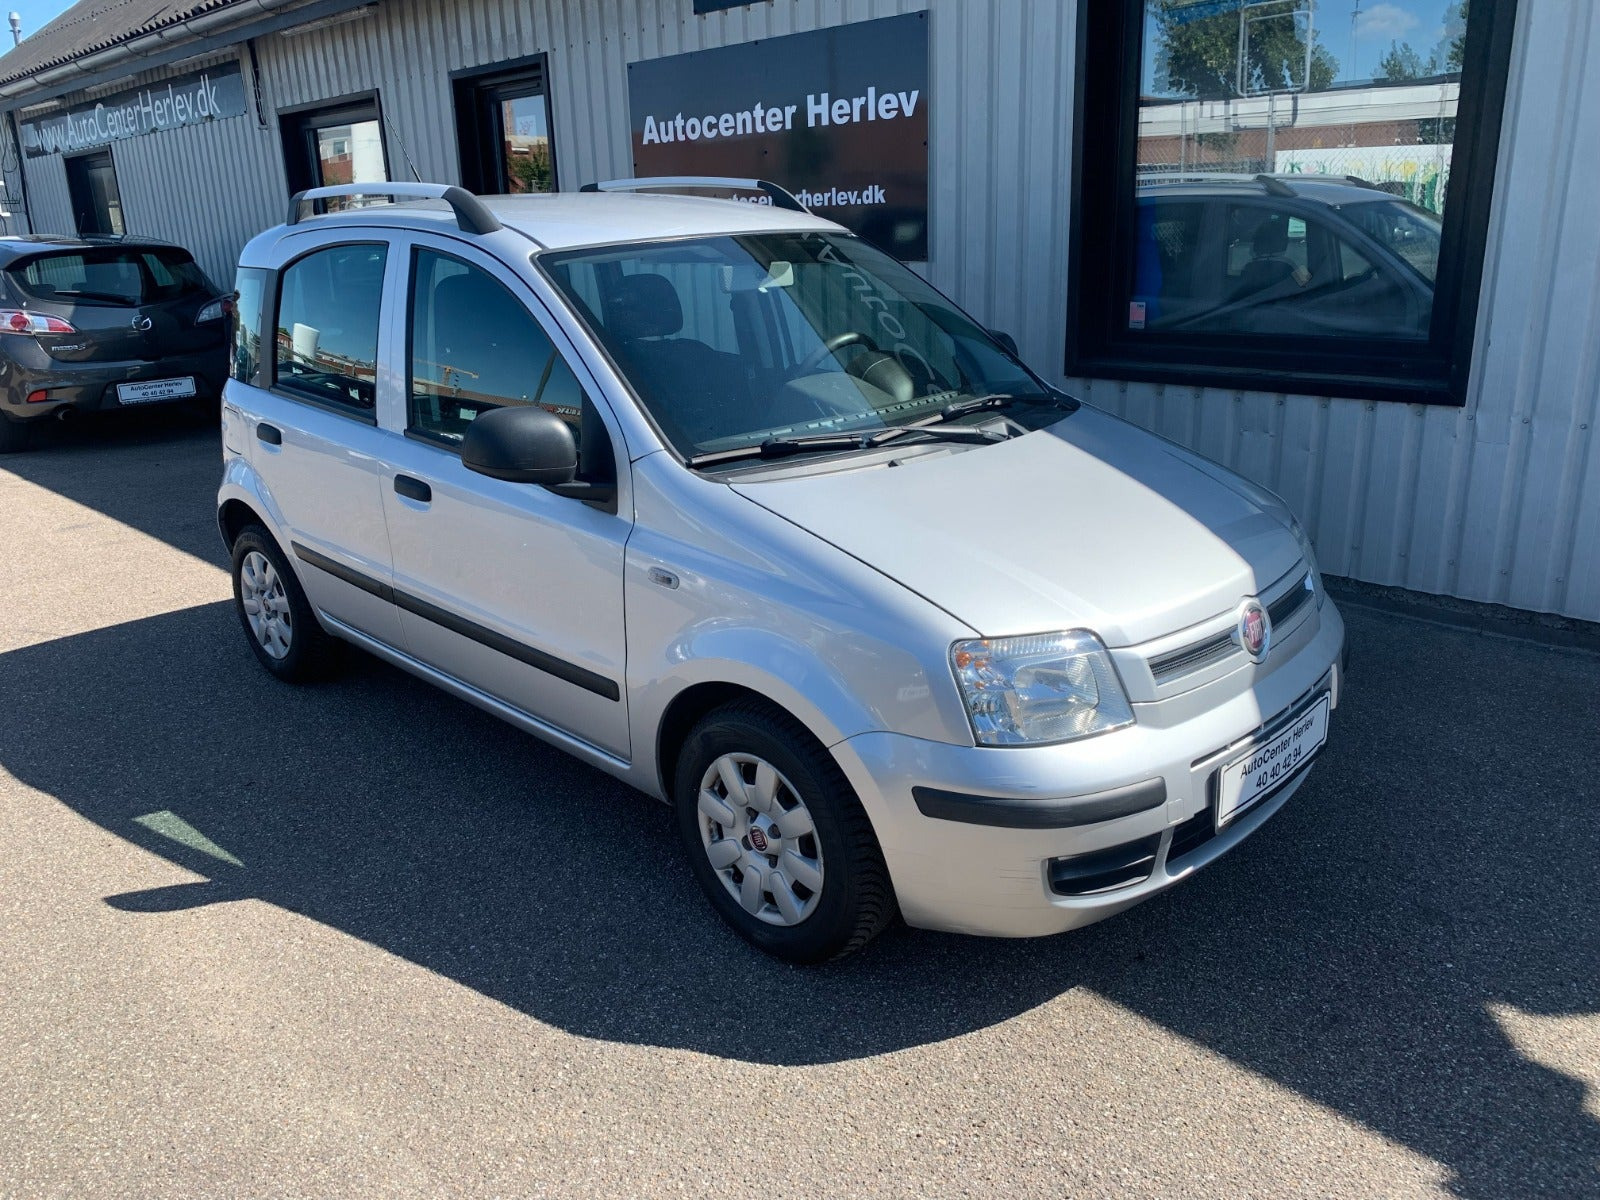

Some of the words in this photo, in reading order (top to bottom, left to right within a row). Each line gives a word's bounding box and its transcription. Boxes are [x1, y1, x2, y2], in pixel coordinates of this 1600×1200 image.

[642, 101, 797, 145] Autocenter
[806, 86, 920, 128] Herlev
[1240, 735, 1292, 779] AutoCenter
[1292, 715, 1315, 742] Herlev
[1255, 771, 1268, 788] 40
[1269, 762, 1280, 780] 40
[1282, 753, 1292, 770] 42
[1293, 744, 1302, 762] 94
